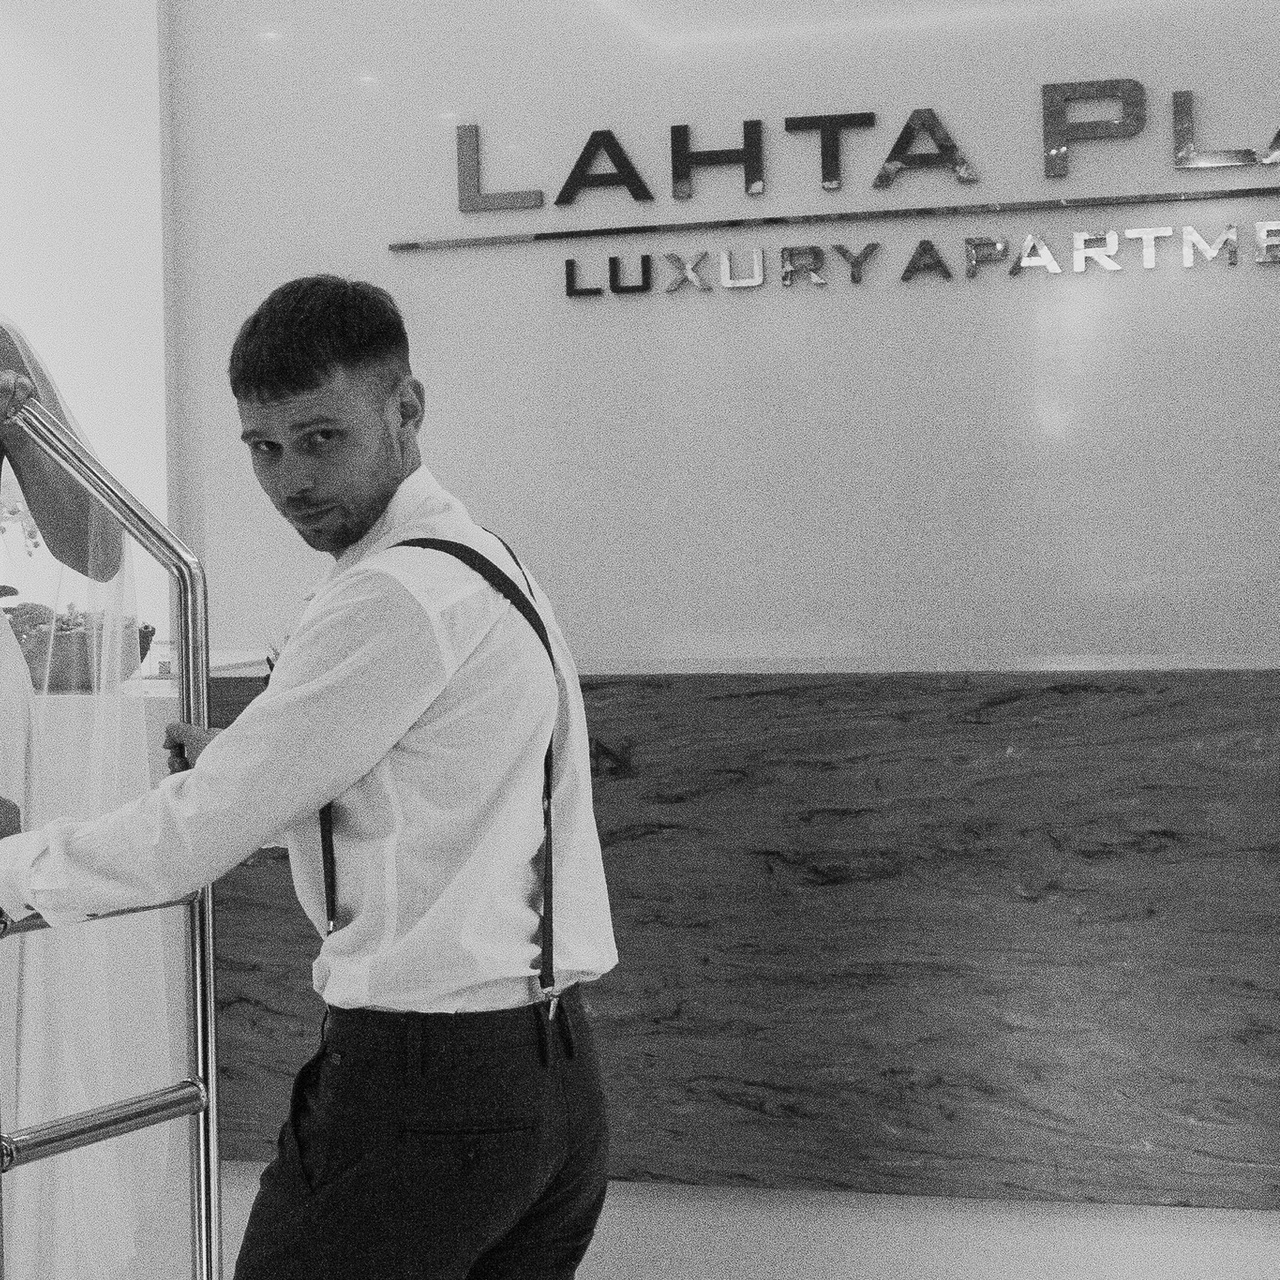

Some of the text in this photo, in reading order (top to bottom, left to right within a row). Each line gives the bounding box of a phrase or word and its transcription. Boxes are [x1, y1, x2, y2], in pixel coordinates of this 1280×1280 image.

[457, 78, 1280, 213] LAHTA PL
[565, 242, 880, 297] LUXURY
